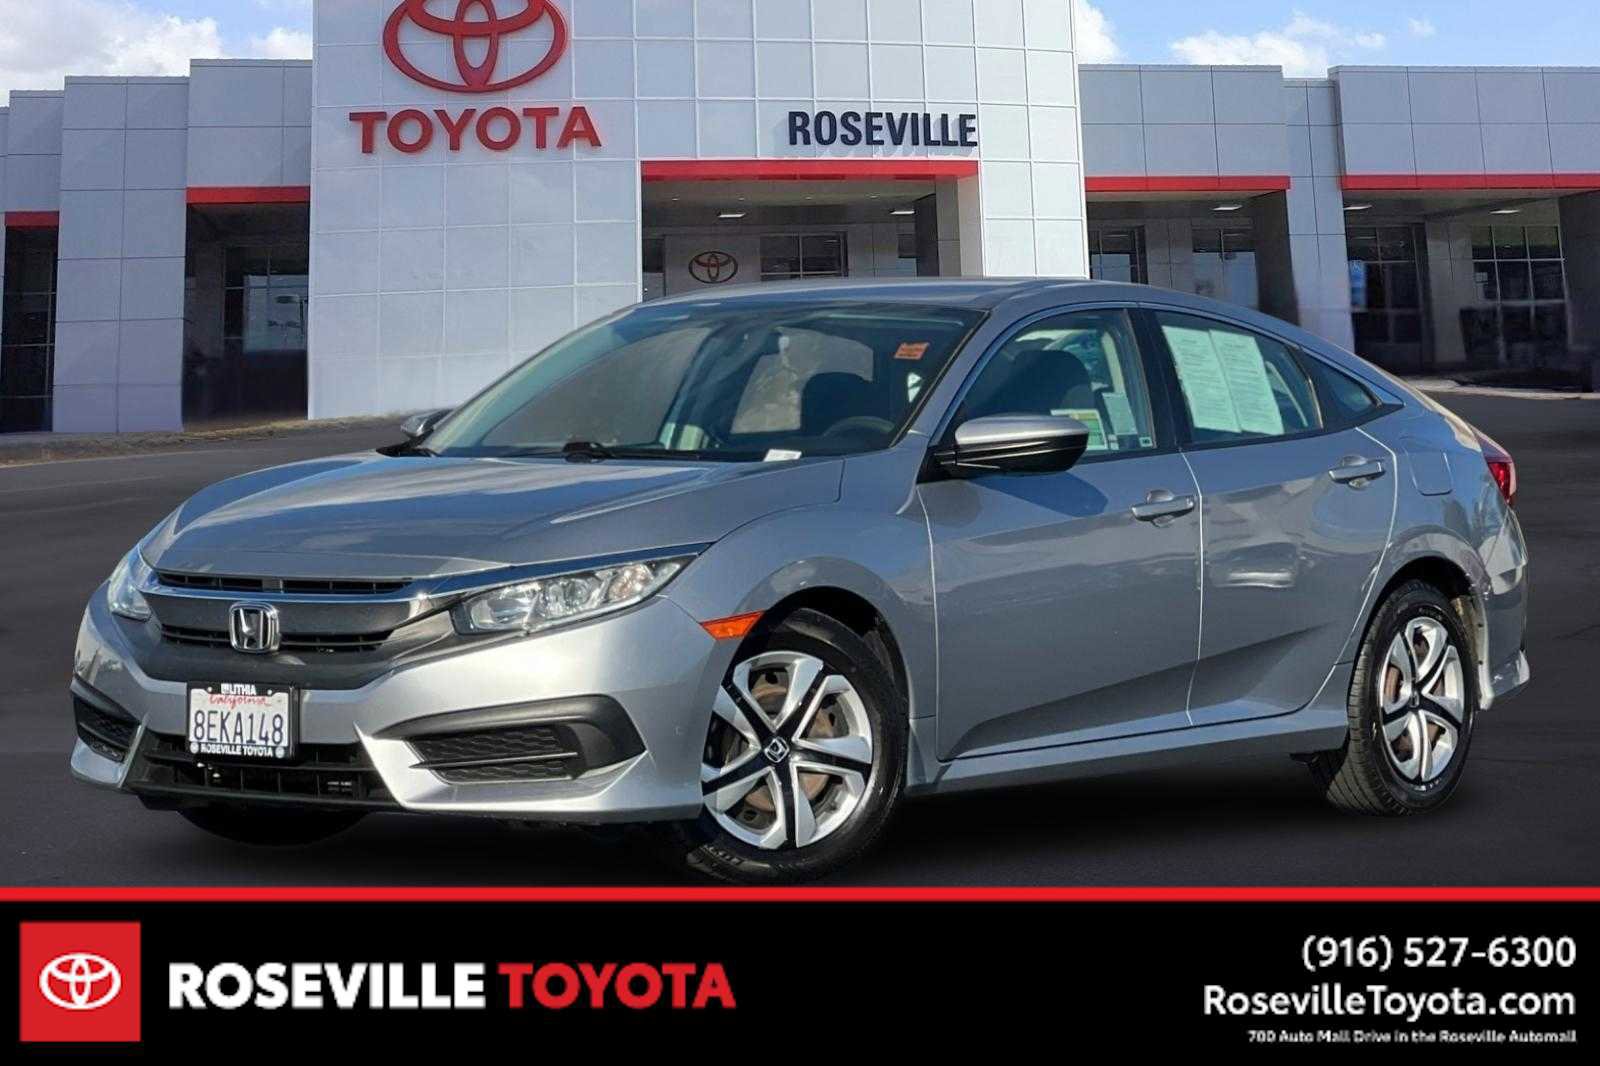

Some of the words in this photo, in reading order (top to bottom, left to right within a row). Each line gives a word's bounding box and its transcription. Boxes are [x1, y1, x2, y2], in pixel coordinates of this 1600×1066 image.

[349, 106, 602, 154] TOYOTA
[788, 110, 978, 147] ROSEVILLE
[193, 710, 284, 744] 8EKA148
[200, 743, 242, 755] ROSEVILLE
[243, 745, 273, 758] TOYOTA
